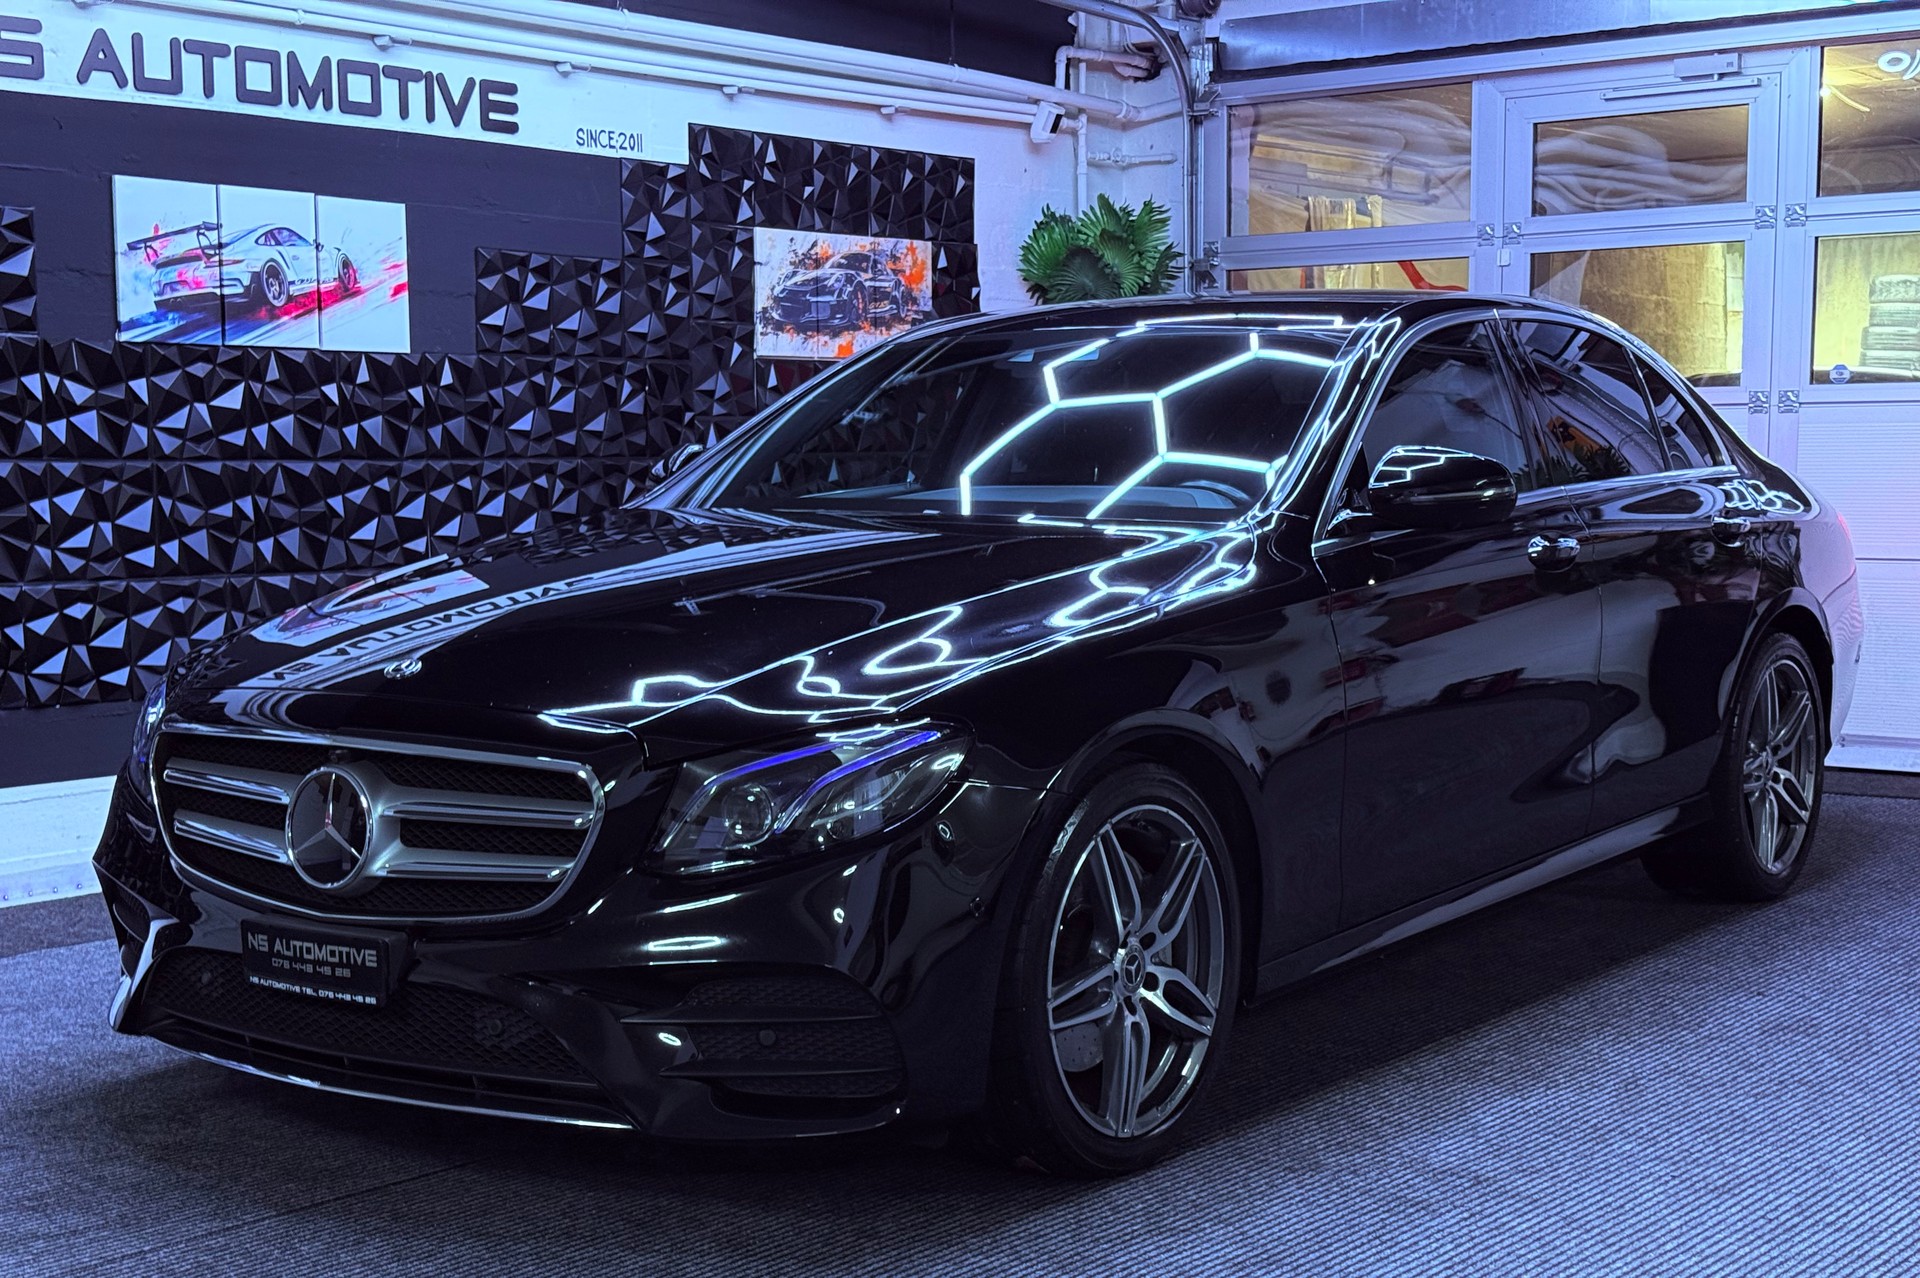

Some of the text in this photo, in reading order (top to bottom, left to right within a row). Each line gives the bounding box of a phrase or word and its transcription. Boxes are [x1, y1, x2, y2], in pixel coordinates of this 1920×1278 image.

[76, 28, 519, 135] AUTOMOTIVE
[618, 132, 643, 153] 2011
[248, 931, 378, 968] NS AUTOMOTIVE
[335, 967, 351, 978] 26
[250, 975, 259, 985] NS
[260, 978, 301, 993] AUTOMOTIVE
